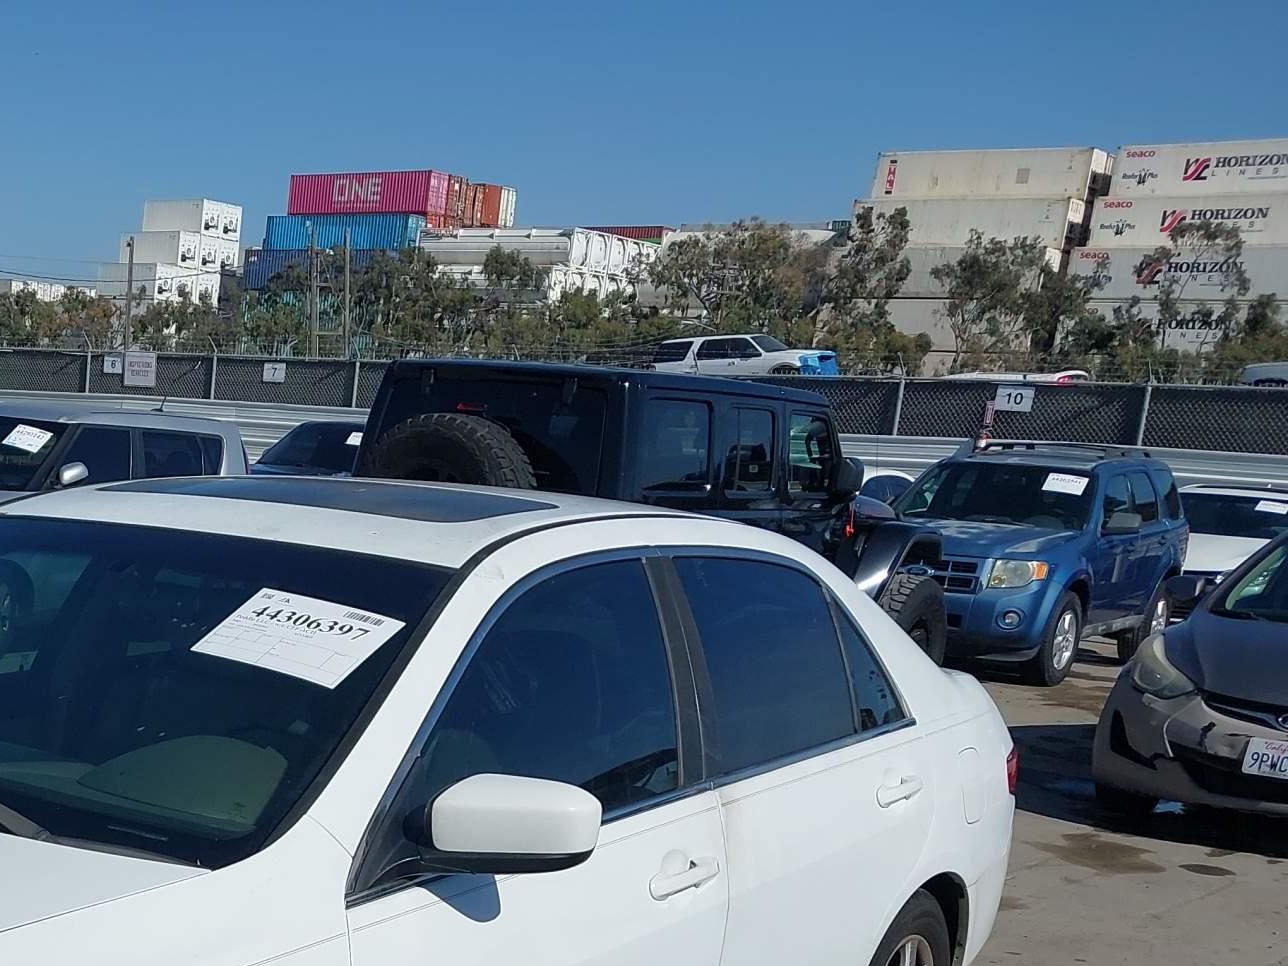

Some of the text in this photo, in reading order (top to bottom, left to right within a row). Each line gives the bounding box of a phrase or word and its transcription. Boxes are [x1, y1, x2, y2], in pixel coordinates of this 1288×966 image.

[1126, 150, 1156, 158] seaco
[1211, 167, 1279, 177] LINES
[332, 177, 382, 201] ONE
[1103, 200, 1133, 209] seaco
[1191, 207, 1270, 221] HORIZON
[1080, 251, 1110, 259] seaco
[1006, 392, 1024, 405] 10
[251, 605, 371, 641] 44306397
